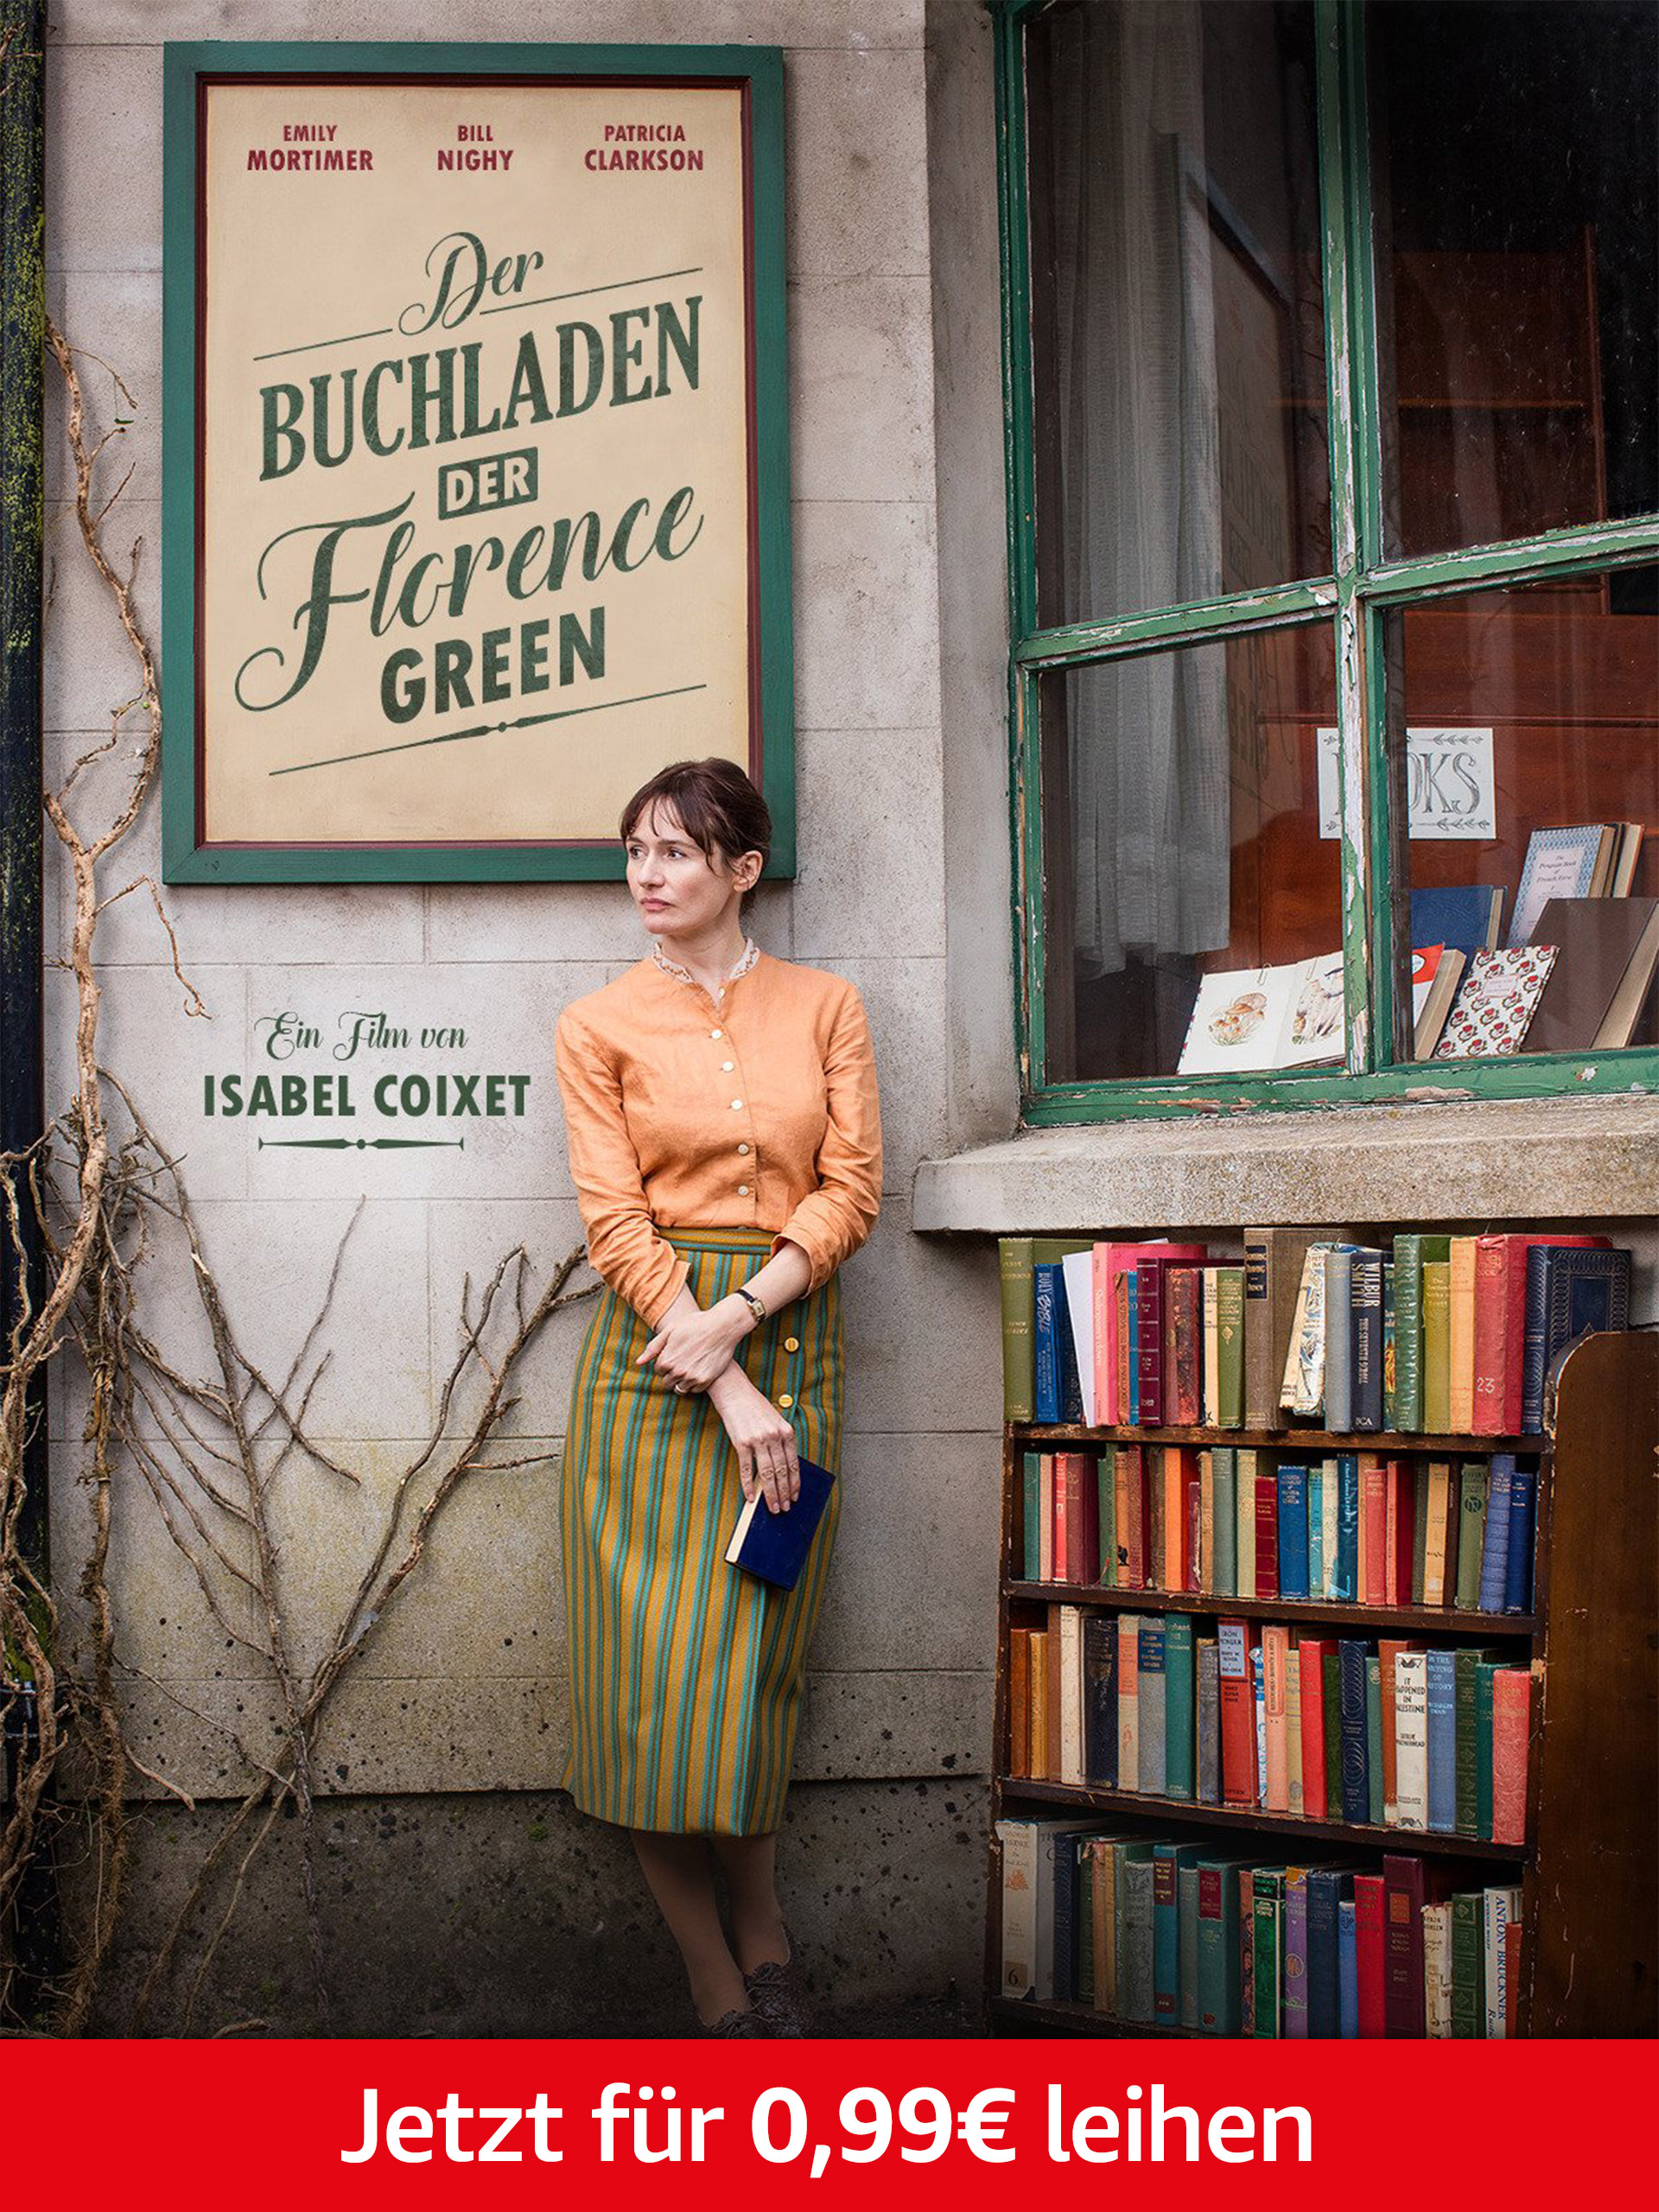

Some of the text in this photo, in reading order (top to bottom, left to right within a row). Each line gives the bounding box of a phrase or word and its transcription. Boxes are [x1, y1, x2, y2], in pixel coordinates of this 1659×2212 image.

[283, 124, 336, 142] EMILY
[457, 124, 493, 142] BILL
[604, 124, 683, 142] PATRICIA
[247, 149, 373, 172] MORTIMER
[437, 149, 512, 171] NIGHY
[585, 149, 703, 172] CLARKSON
[398, 232, 544, 335] Der
[259, 295, 703, 482] BUCHLADEN
[446, 456, 531, 512] DER
[234, 486, 704, 712] Florence
[380, 606, 606, 724] GREEN
[1332, 752, 1480, 815] OKS
[1039, 1273, 1053, 1293] HOLY
[1351, 1262, 1365, 1307] SMITH
[1364, 1262, 1381, 1307] WILBUR
[1037, 1294, 1052, 1333] BIBLE
[1477, 1376, 1495, 1394] 23
[1403, 1695, 1413, 1704] IN
[1496, 1897, 1507, 2020] ANTON BRUCKNER
[1008, 1968, 1019, 1986] 6
